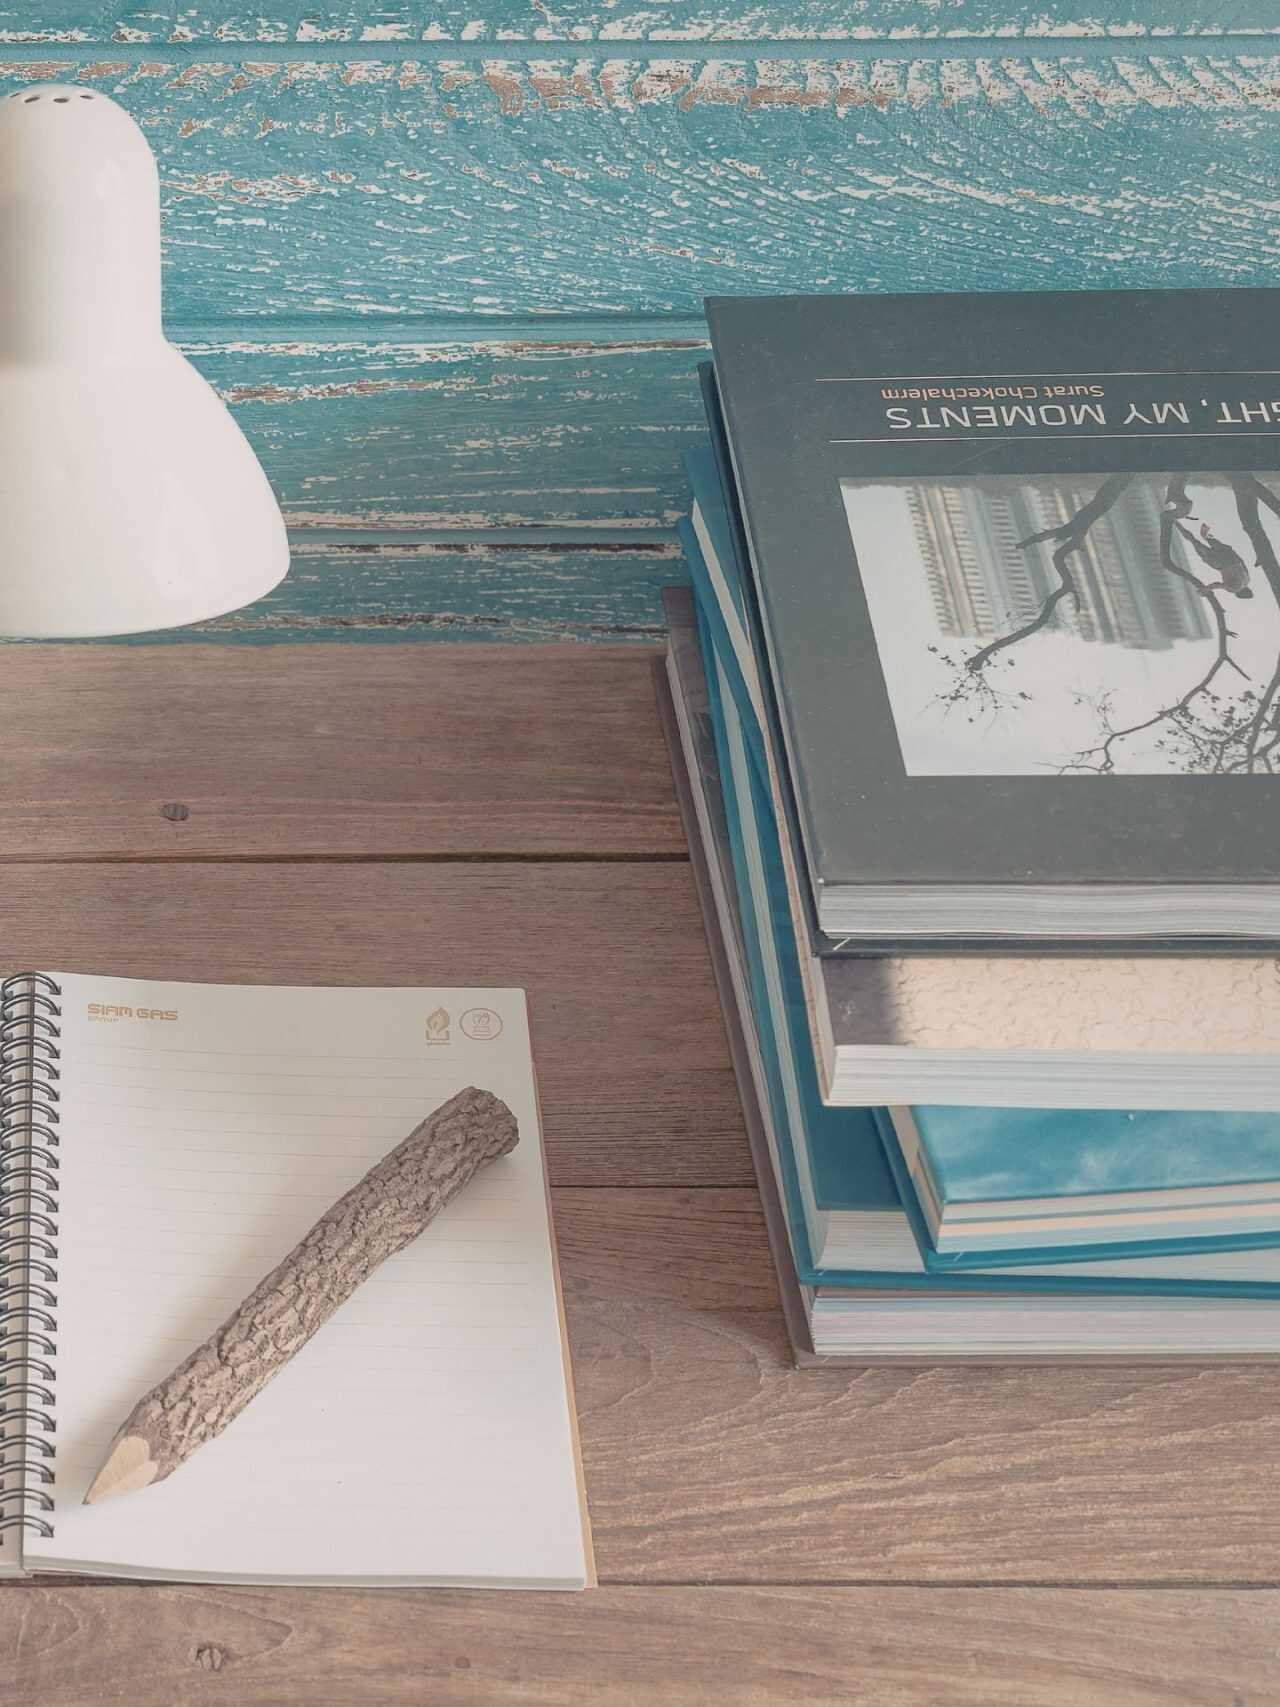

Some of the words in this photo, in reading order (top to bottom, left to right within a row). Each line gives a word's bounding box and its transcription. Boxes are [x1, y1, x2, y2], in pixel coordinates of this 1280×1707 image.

[881, 386, 1038, 401] Chokechalerm
[1045, 384, 1105, 398] Surat
[886, 403, 1106, 429] MOMENTS
[1123, 402, 1190, 425] MY
[88, 1003, 132, 1017] SIAM
[136, 1008, 178, 1021] GAS
